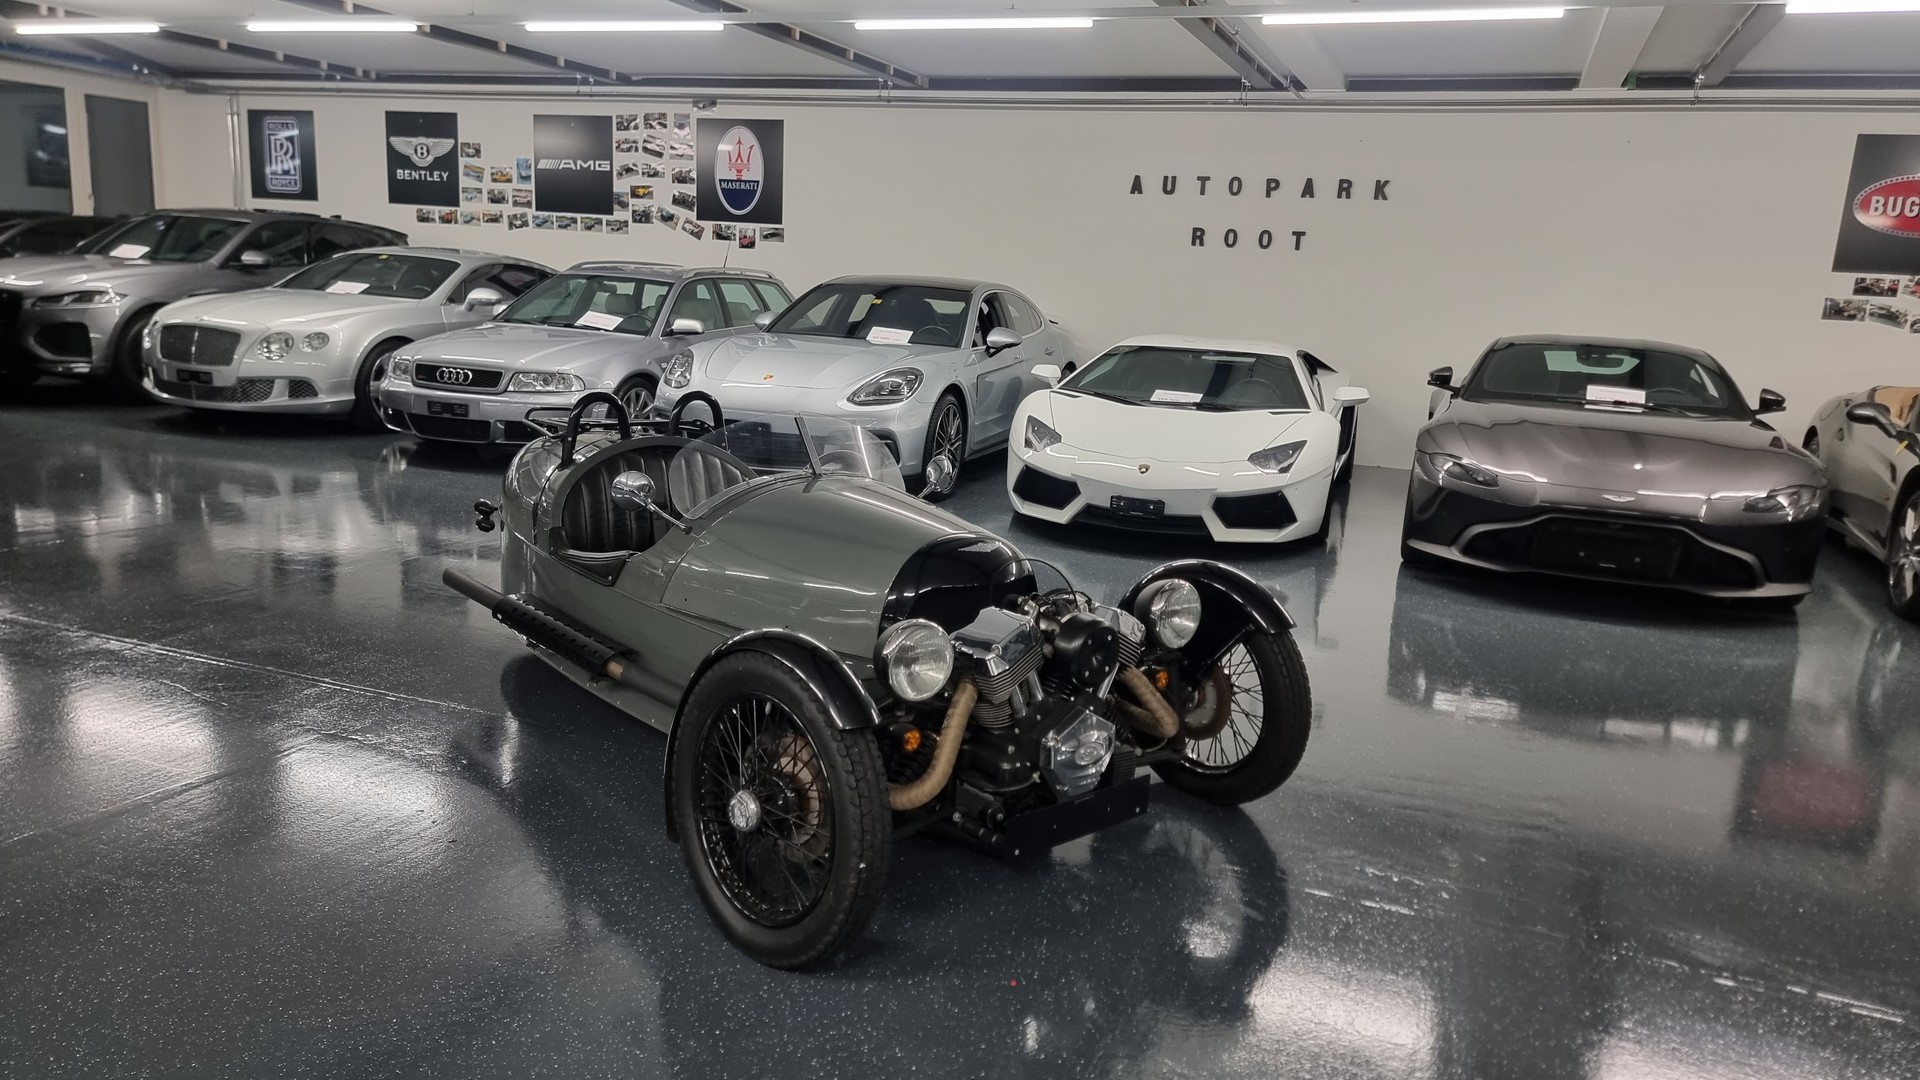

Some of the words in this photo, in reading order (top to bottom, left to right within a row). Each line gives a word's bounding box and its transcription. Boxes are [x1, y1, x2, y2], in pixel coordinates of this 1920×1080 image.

[558, 160, 610, 171] AMG
[396, 169, 449, 182] BENTLEY
[720, 180, 758, 191] MASERATI
[1129, 175, 1390, 201] AUTOPARK
[1191, 227, 1306, 250] ROOT
